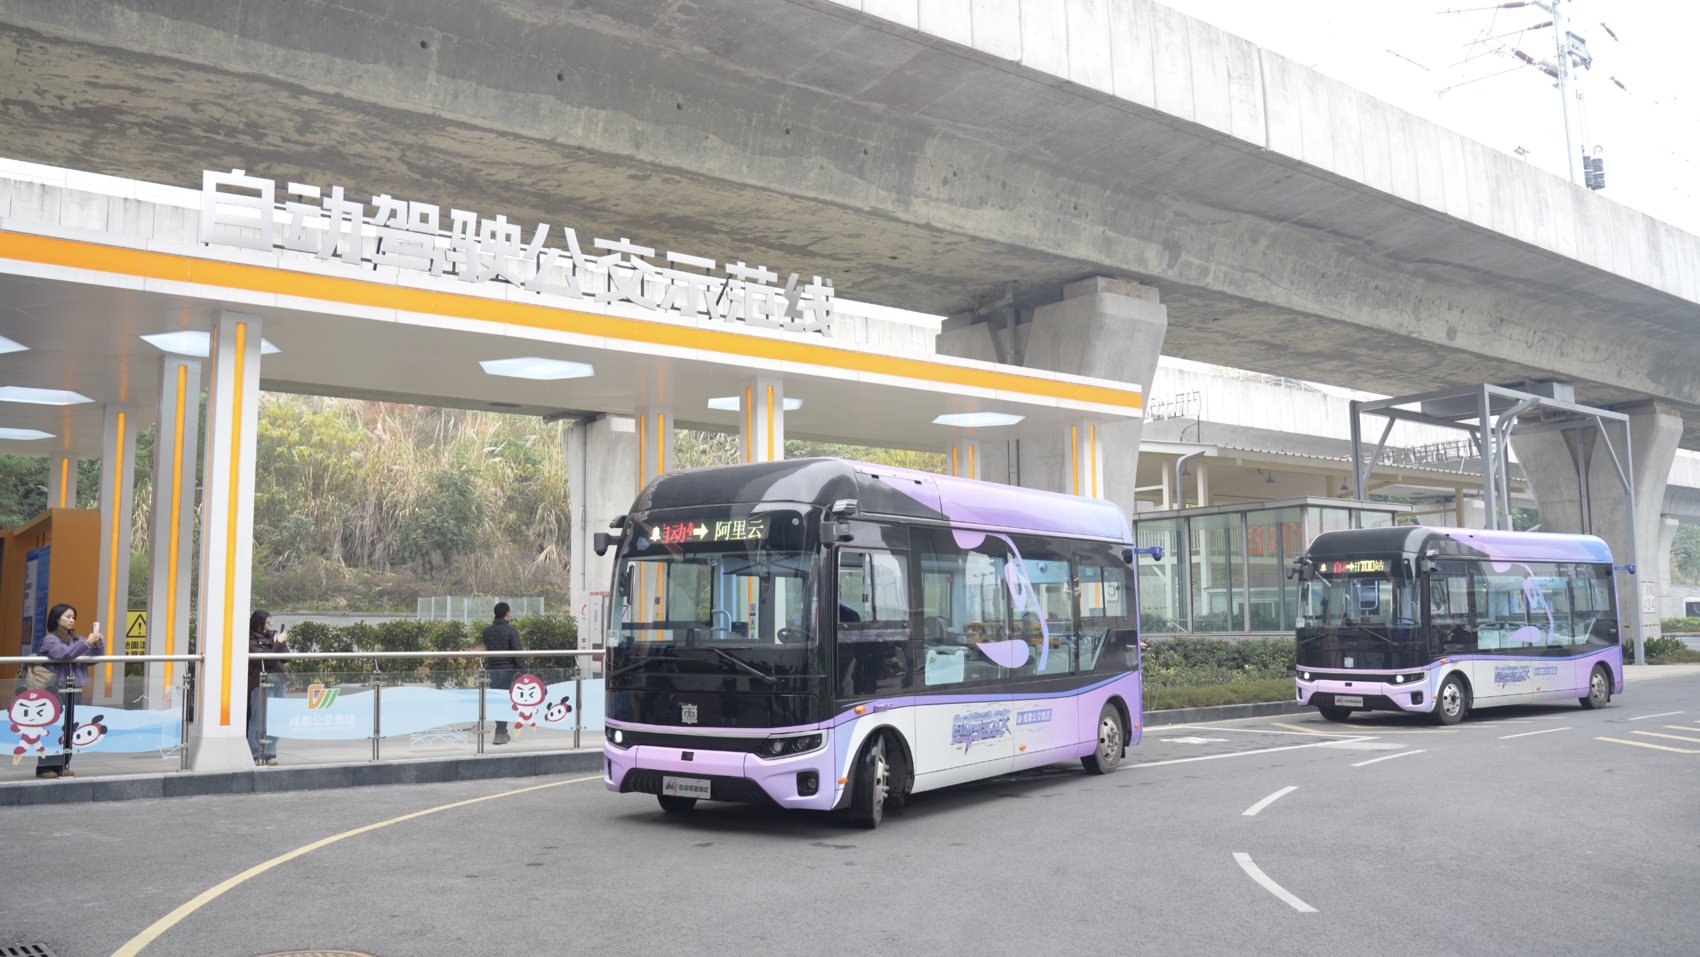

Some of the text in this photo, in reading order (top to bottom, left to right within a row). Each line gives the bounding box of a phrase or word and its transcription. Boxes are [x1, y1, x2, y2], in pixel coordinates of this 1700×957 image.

[201, 168, 835, 337] 自动驾驶公交示范线
[714, 519, 764, 541] 阿里云
[290, 714, 356, 727] 成都公交集团
